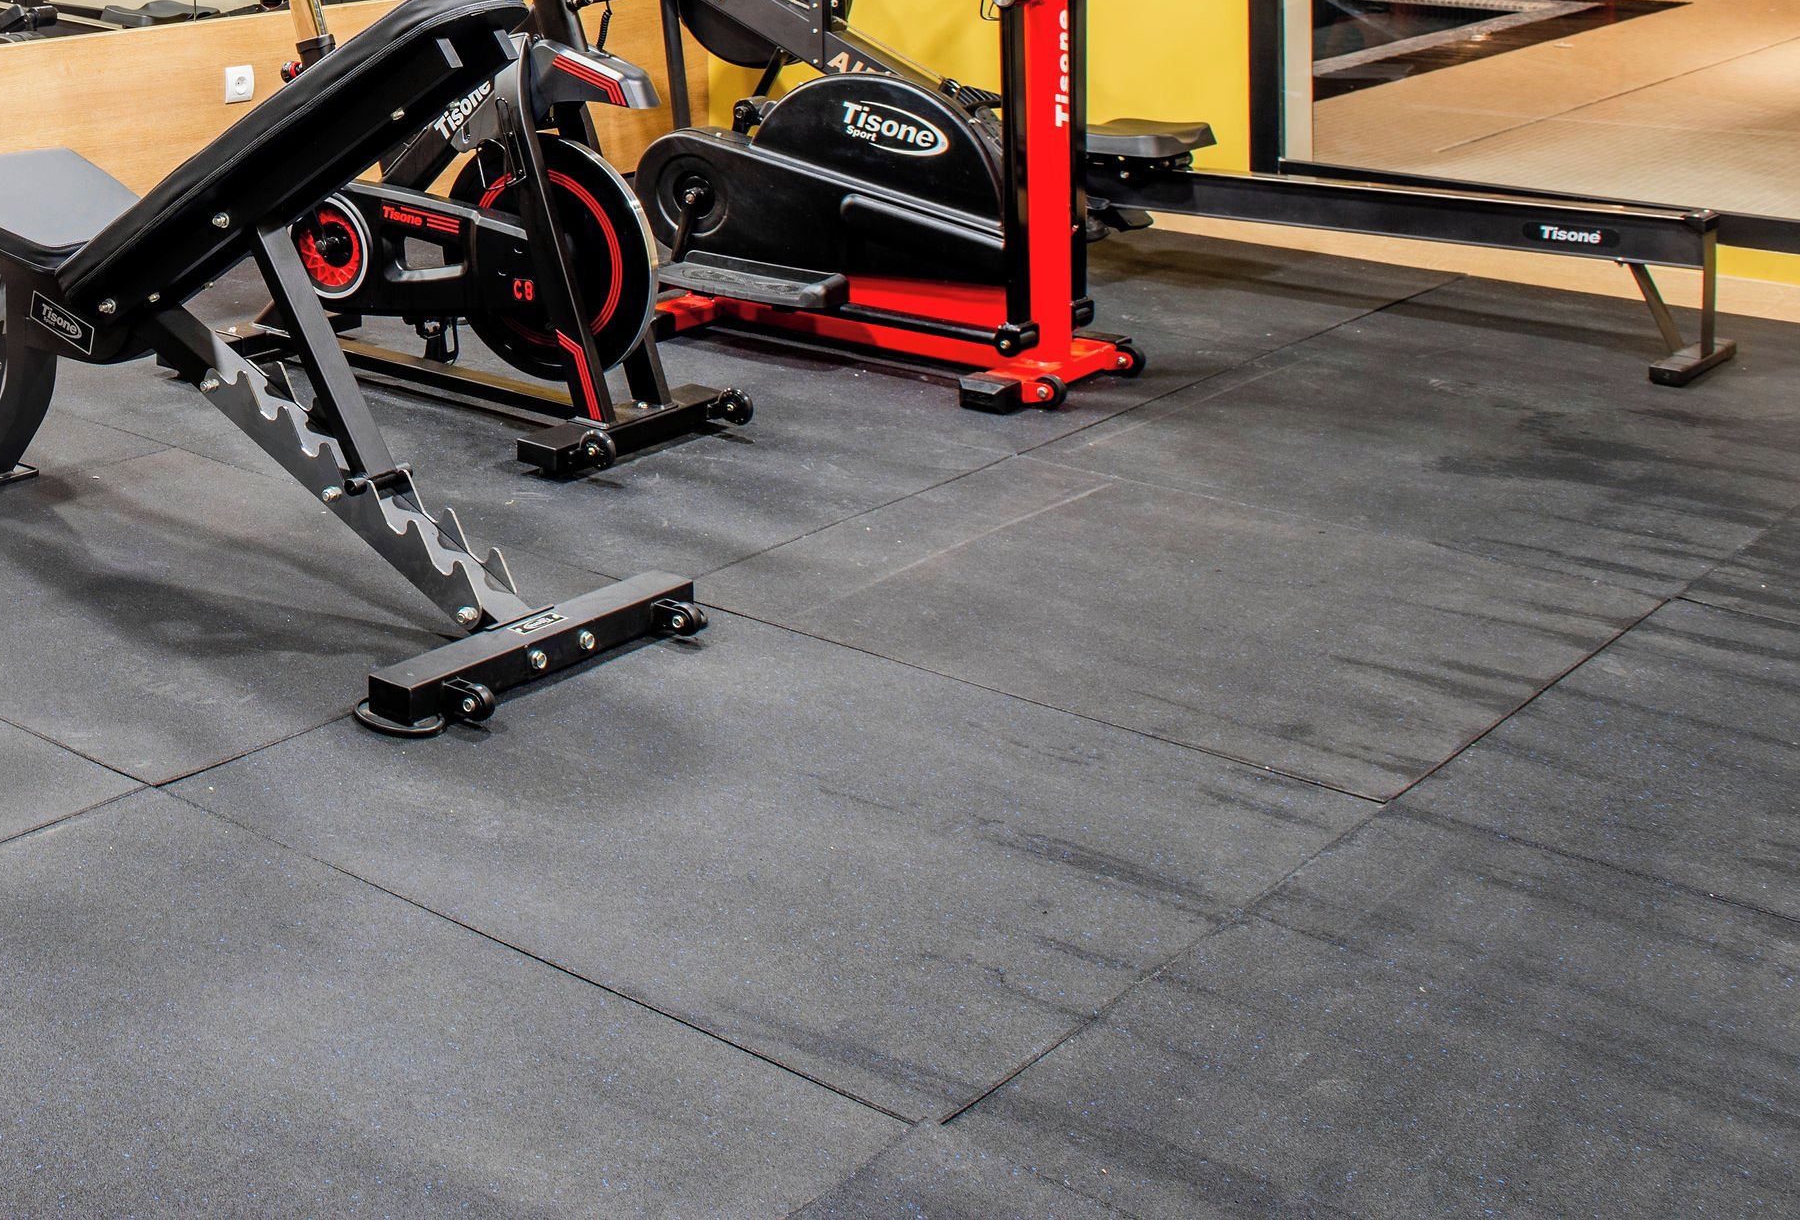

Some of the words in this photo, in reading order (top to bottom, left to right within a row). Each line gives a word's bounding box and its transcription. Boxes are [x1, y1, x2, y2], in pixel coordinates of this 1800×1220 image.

[843, 100, 935, 148] Tisone
[845, 125, 878, 142] Sport
[382, 205, 423, 226] Tisone
[1540, 225, 1601, 244] Tisone
[41, 303, 77, 335] Tisone
